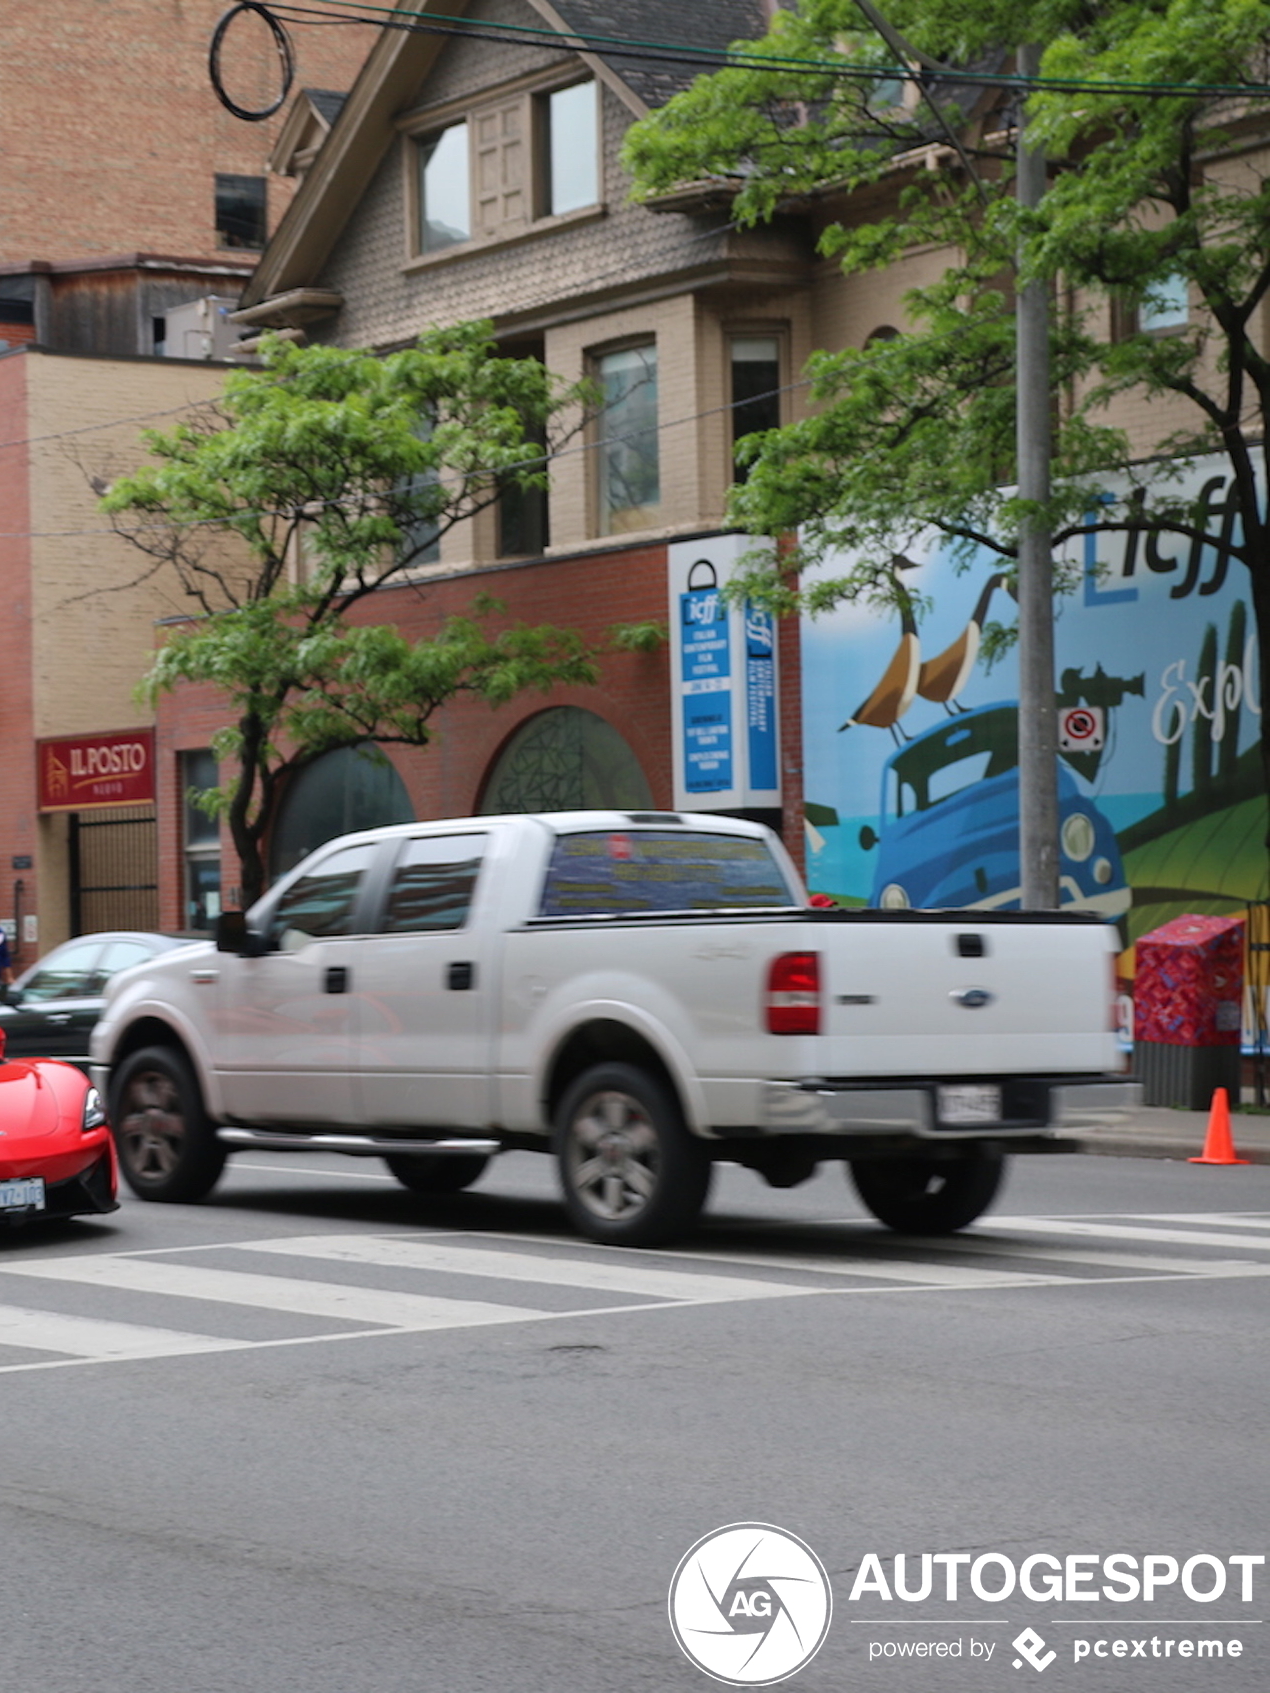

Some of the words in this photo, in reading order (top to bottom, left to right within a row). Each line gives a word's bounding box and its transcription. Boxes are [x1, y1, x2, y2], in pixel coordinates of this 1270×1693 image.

[691, 594, 718, 625] icff
[70, 748, 88, 776] IL
[87, 742, 146, 775] POSTO
